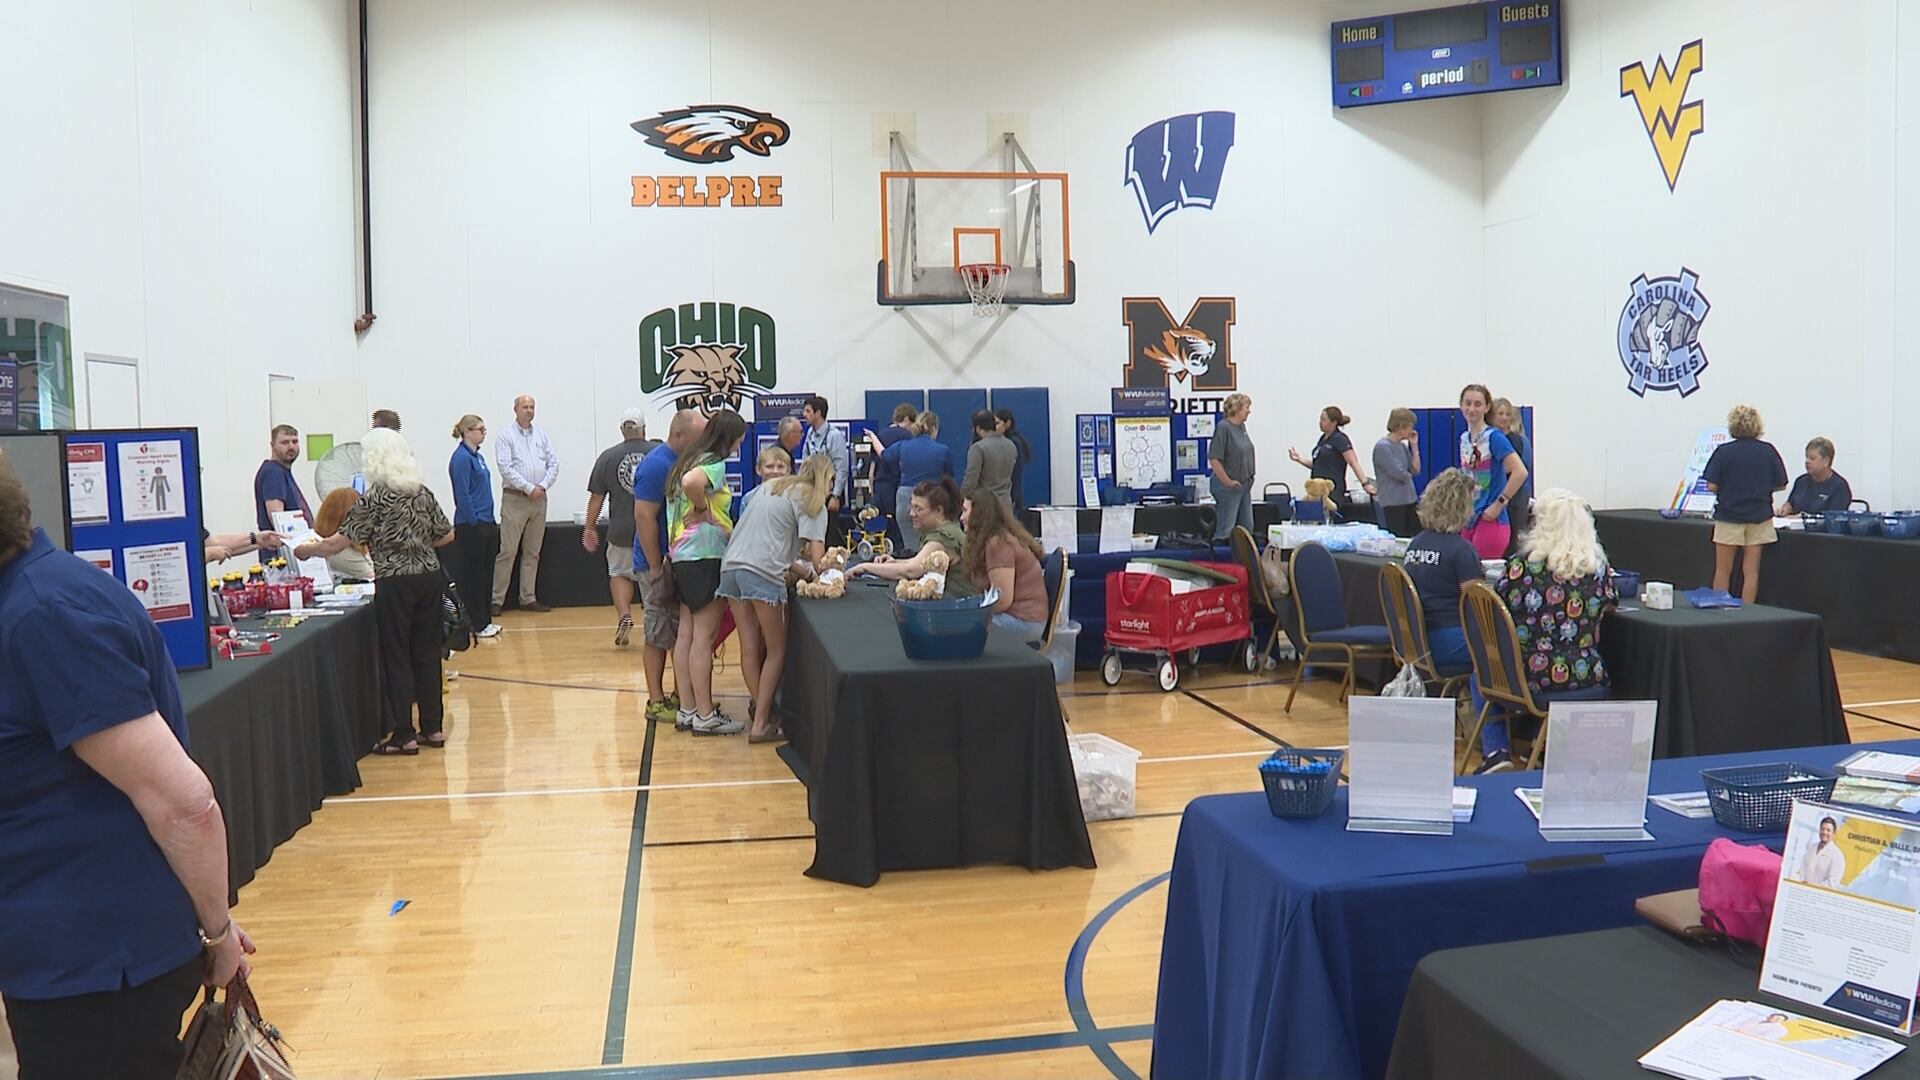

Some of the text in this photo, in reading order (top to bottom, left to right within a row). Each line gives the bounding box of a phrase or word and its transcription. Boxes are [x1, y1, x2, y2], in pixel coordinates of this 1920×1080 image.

[1502, 4, 1549, 23] Guests
[1342, 27, 1377, 44] Home
[1421, 66, 1464, 88] period
[1124, 110, 1235, 236] W
[631, 176, 783, 208] BELPRE
[1628, 285, 1696, 320] CAROLINA
[639, 302, 777, 394] OHIO
[1630, 353, 1699, 383] TAR HEELS
[1120, 618, 1150, 631] starlight
[1847, 832, 1881, 846] CHRISTIAN
